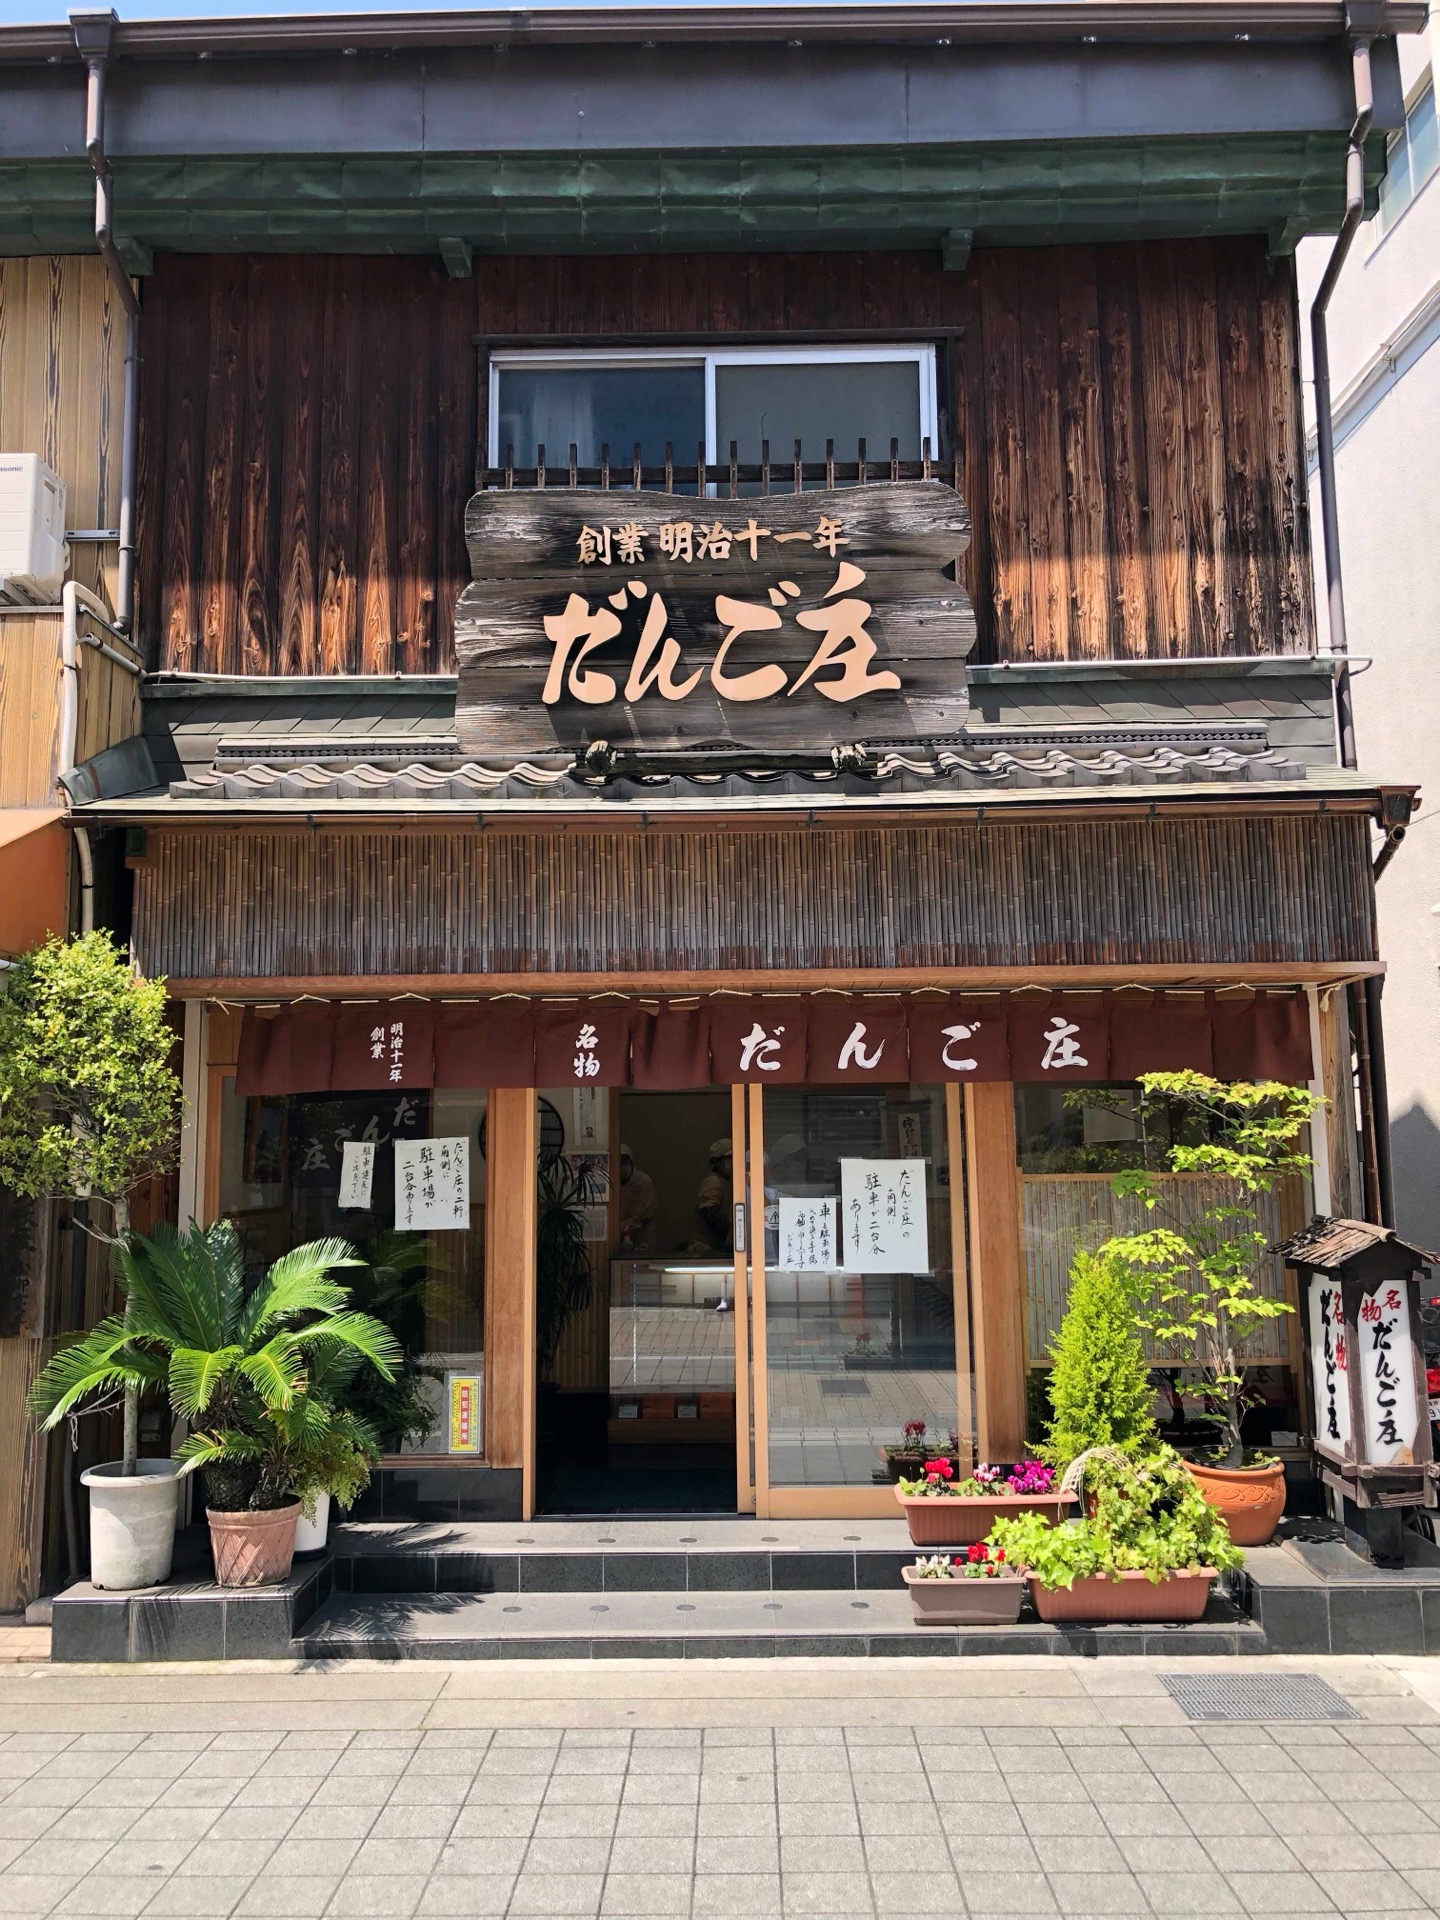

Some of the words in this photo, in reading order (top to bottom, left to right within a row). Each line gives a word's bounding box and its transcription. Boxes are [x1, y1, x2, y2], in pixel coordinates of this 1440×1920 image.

[577, 525, 647, 565] 創業
[659, 517, 850, 563] 明治十一年
[541, 562, 902, 704] だんご庄
[370, 1026, 386, 1060] 創業
[389, 1022, 404, 1083] 明治十一年
[573, 1023, 601, 1078] 名物
[739, 1017, 1089, 1072] だんご庄
[1362, 1290, 1401, 1321] 名物
[1319, 1288, 1340, 1440] だんご庄
[1372, 1317, 1403, 1446] だんご庄
